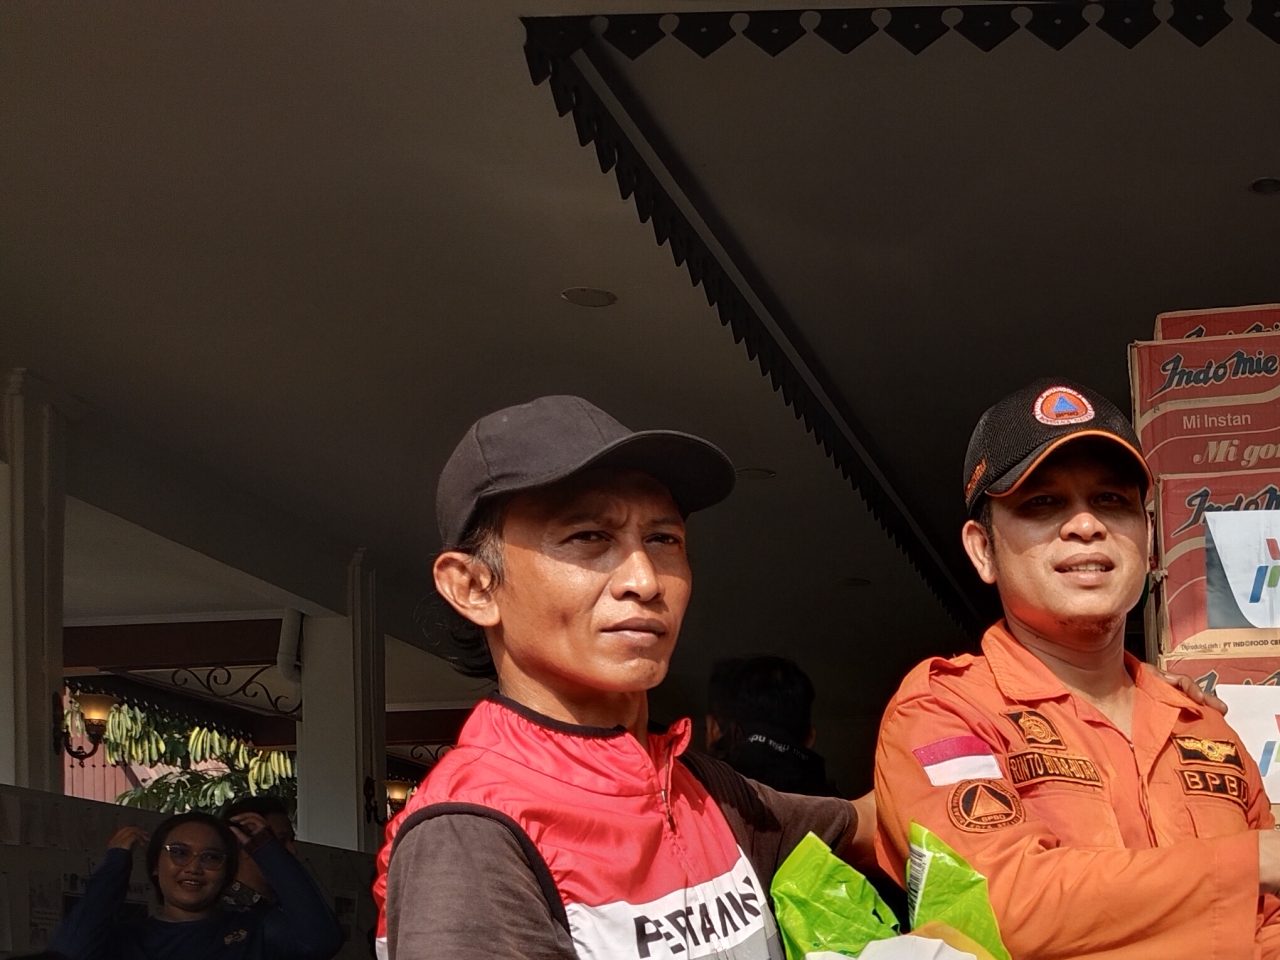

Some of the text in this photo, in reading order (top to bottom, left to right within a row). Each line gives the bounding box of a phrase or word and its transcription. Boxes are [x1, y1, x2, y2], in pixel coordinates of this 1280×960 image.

[1183, 412, 1252, 430] Mi Instan
[1192, 438, 1240, 465] Mi
